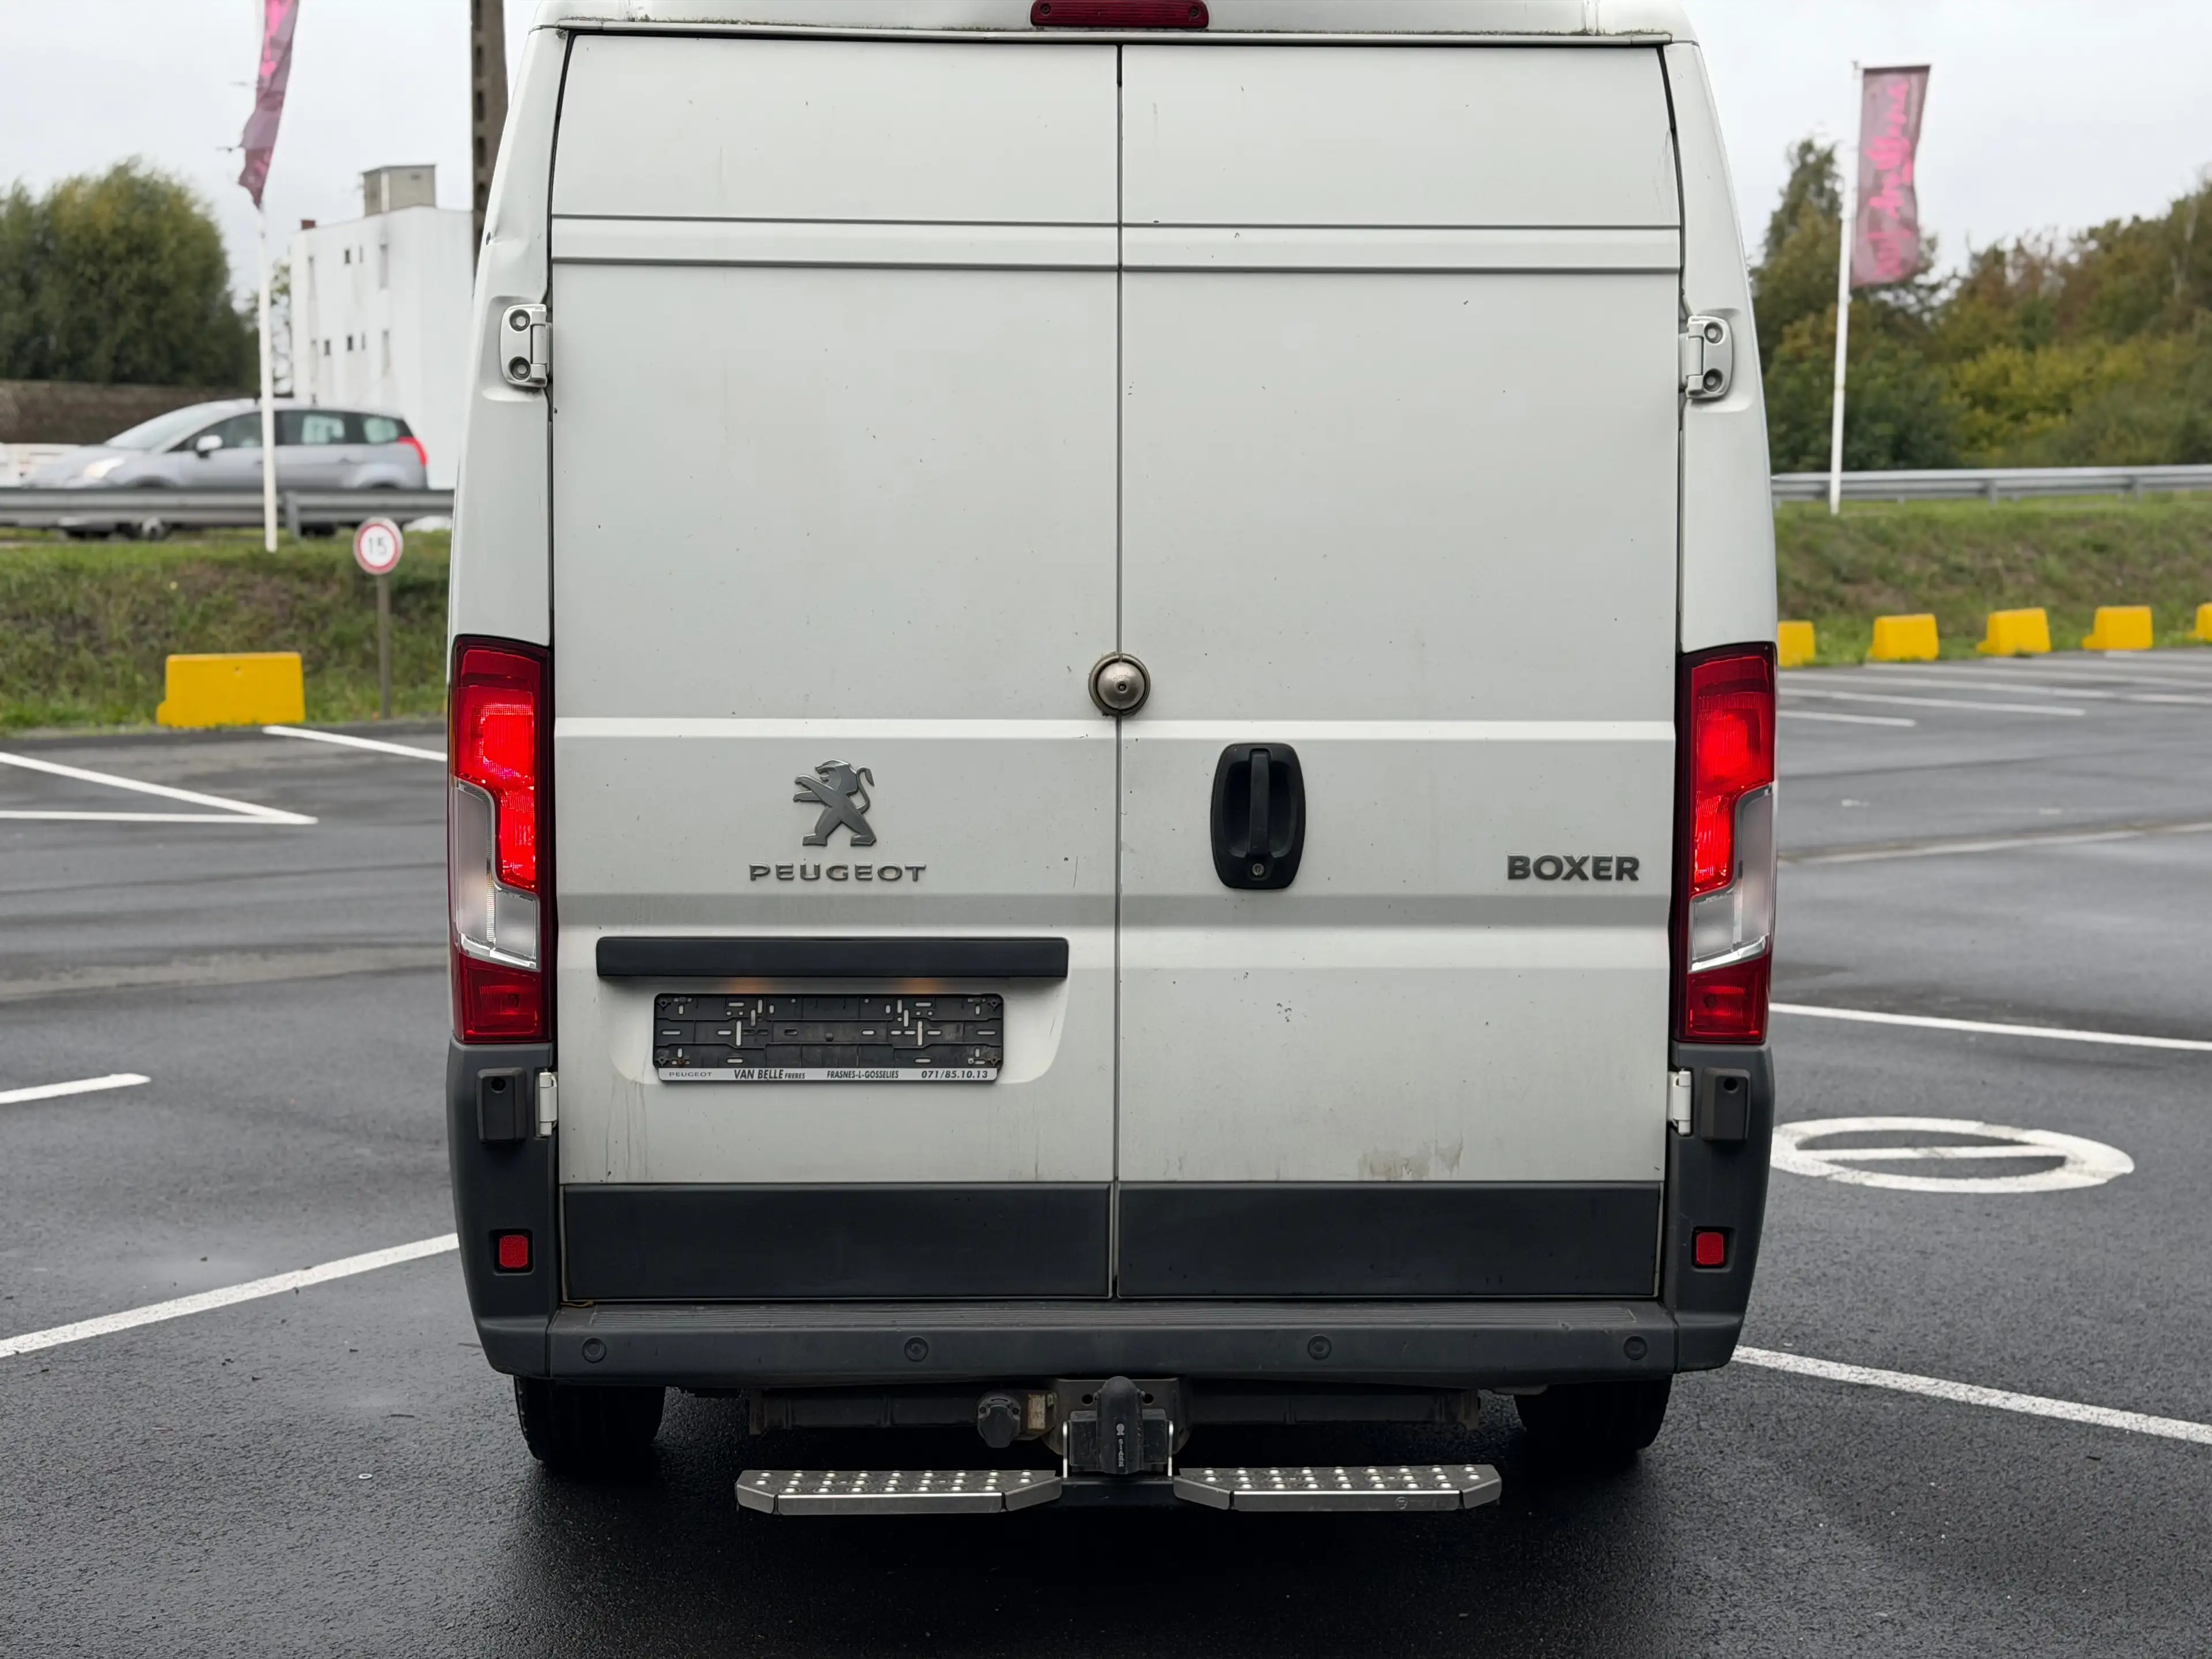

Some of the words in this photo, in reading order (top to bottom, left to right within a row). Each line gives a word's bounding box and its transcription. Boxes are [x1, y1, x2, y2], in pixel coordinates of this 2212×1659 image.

[368, 536, 387, 555] 15
[749, 863, 927, 882] PEUGEOT
[1507, 854, 1639, 881] BOXER
[733, 1069, 755, 1079] VAN
[757, 1069, 784, 1079] BELLE
[827, 1070, 899, 1079] FRASNES-L-GOSSELIES
[921, 1070, 988, 1079] 071/85.10.13
